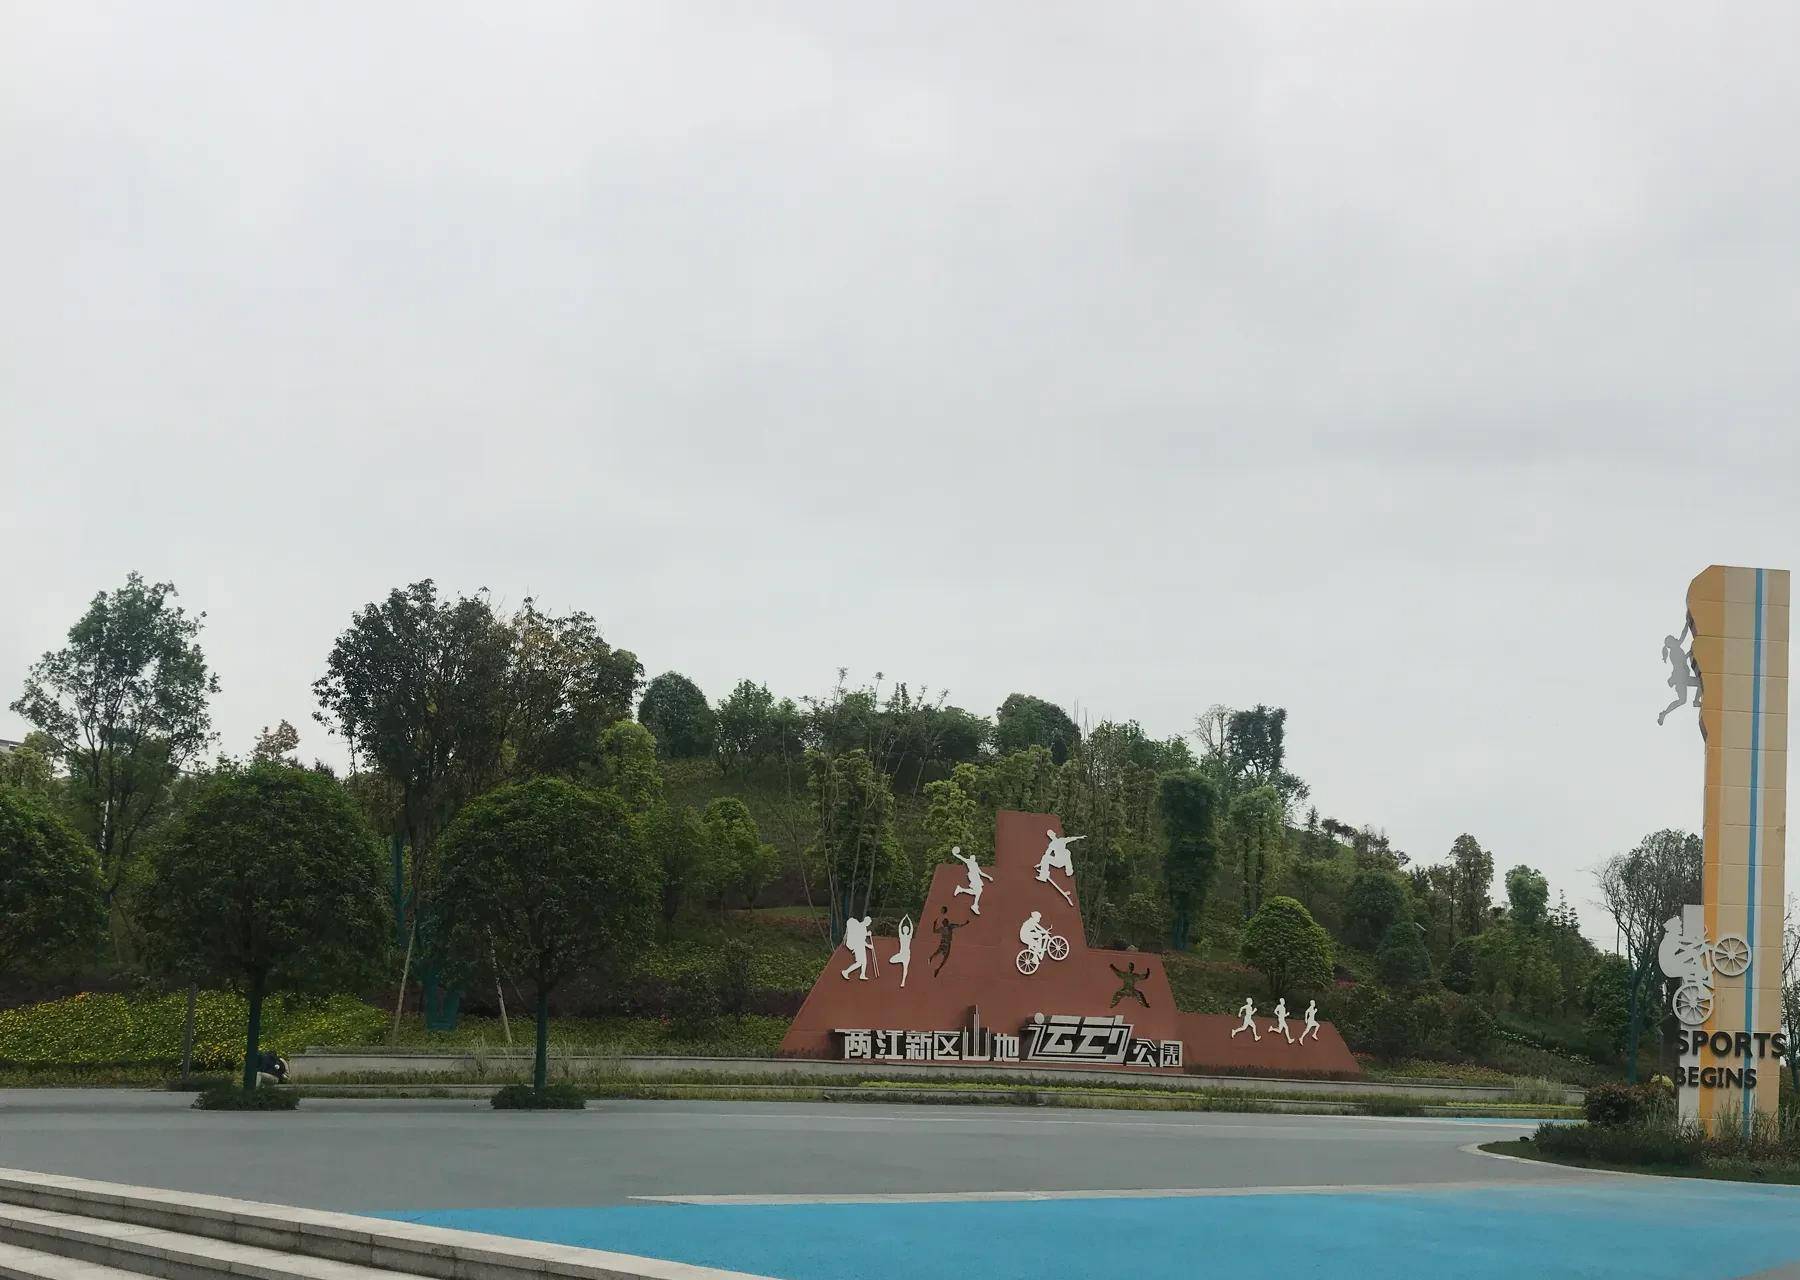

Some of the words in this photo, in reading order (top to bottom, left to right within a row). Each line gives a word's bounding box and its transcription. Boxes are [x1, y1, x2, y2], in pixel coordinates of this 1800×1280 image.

[834, 1004, 1184, 1068] 两江新区山地运动公园
[1676, 1029, 1787, 1058] SPORTS
[1675, 1066, 1758, 1089] BEGINS
